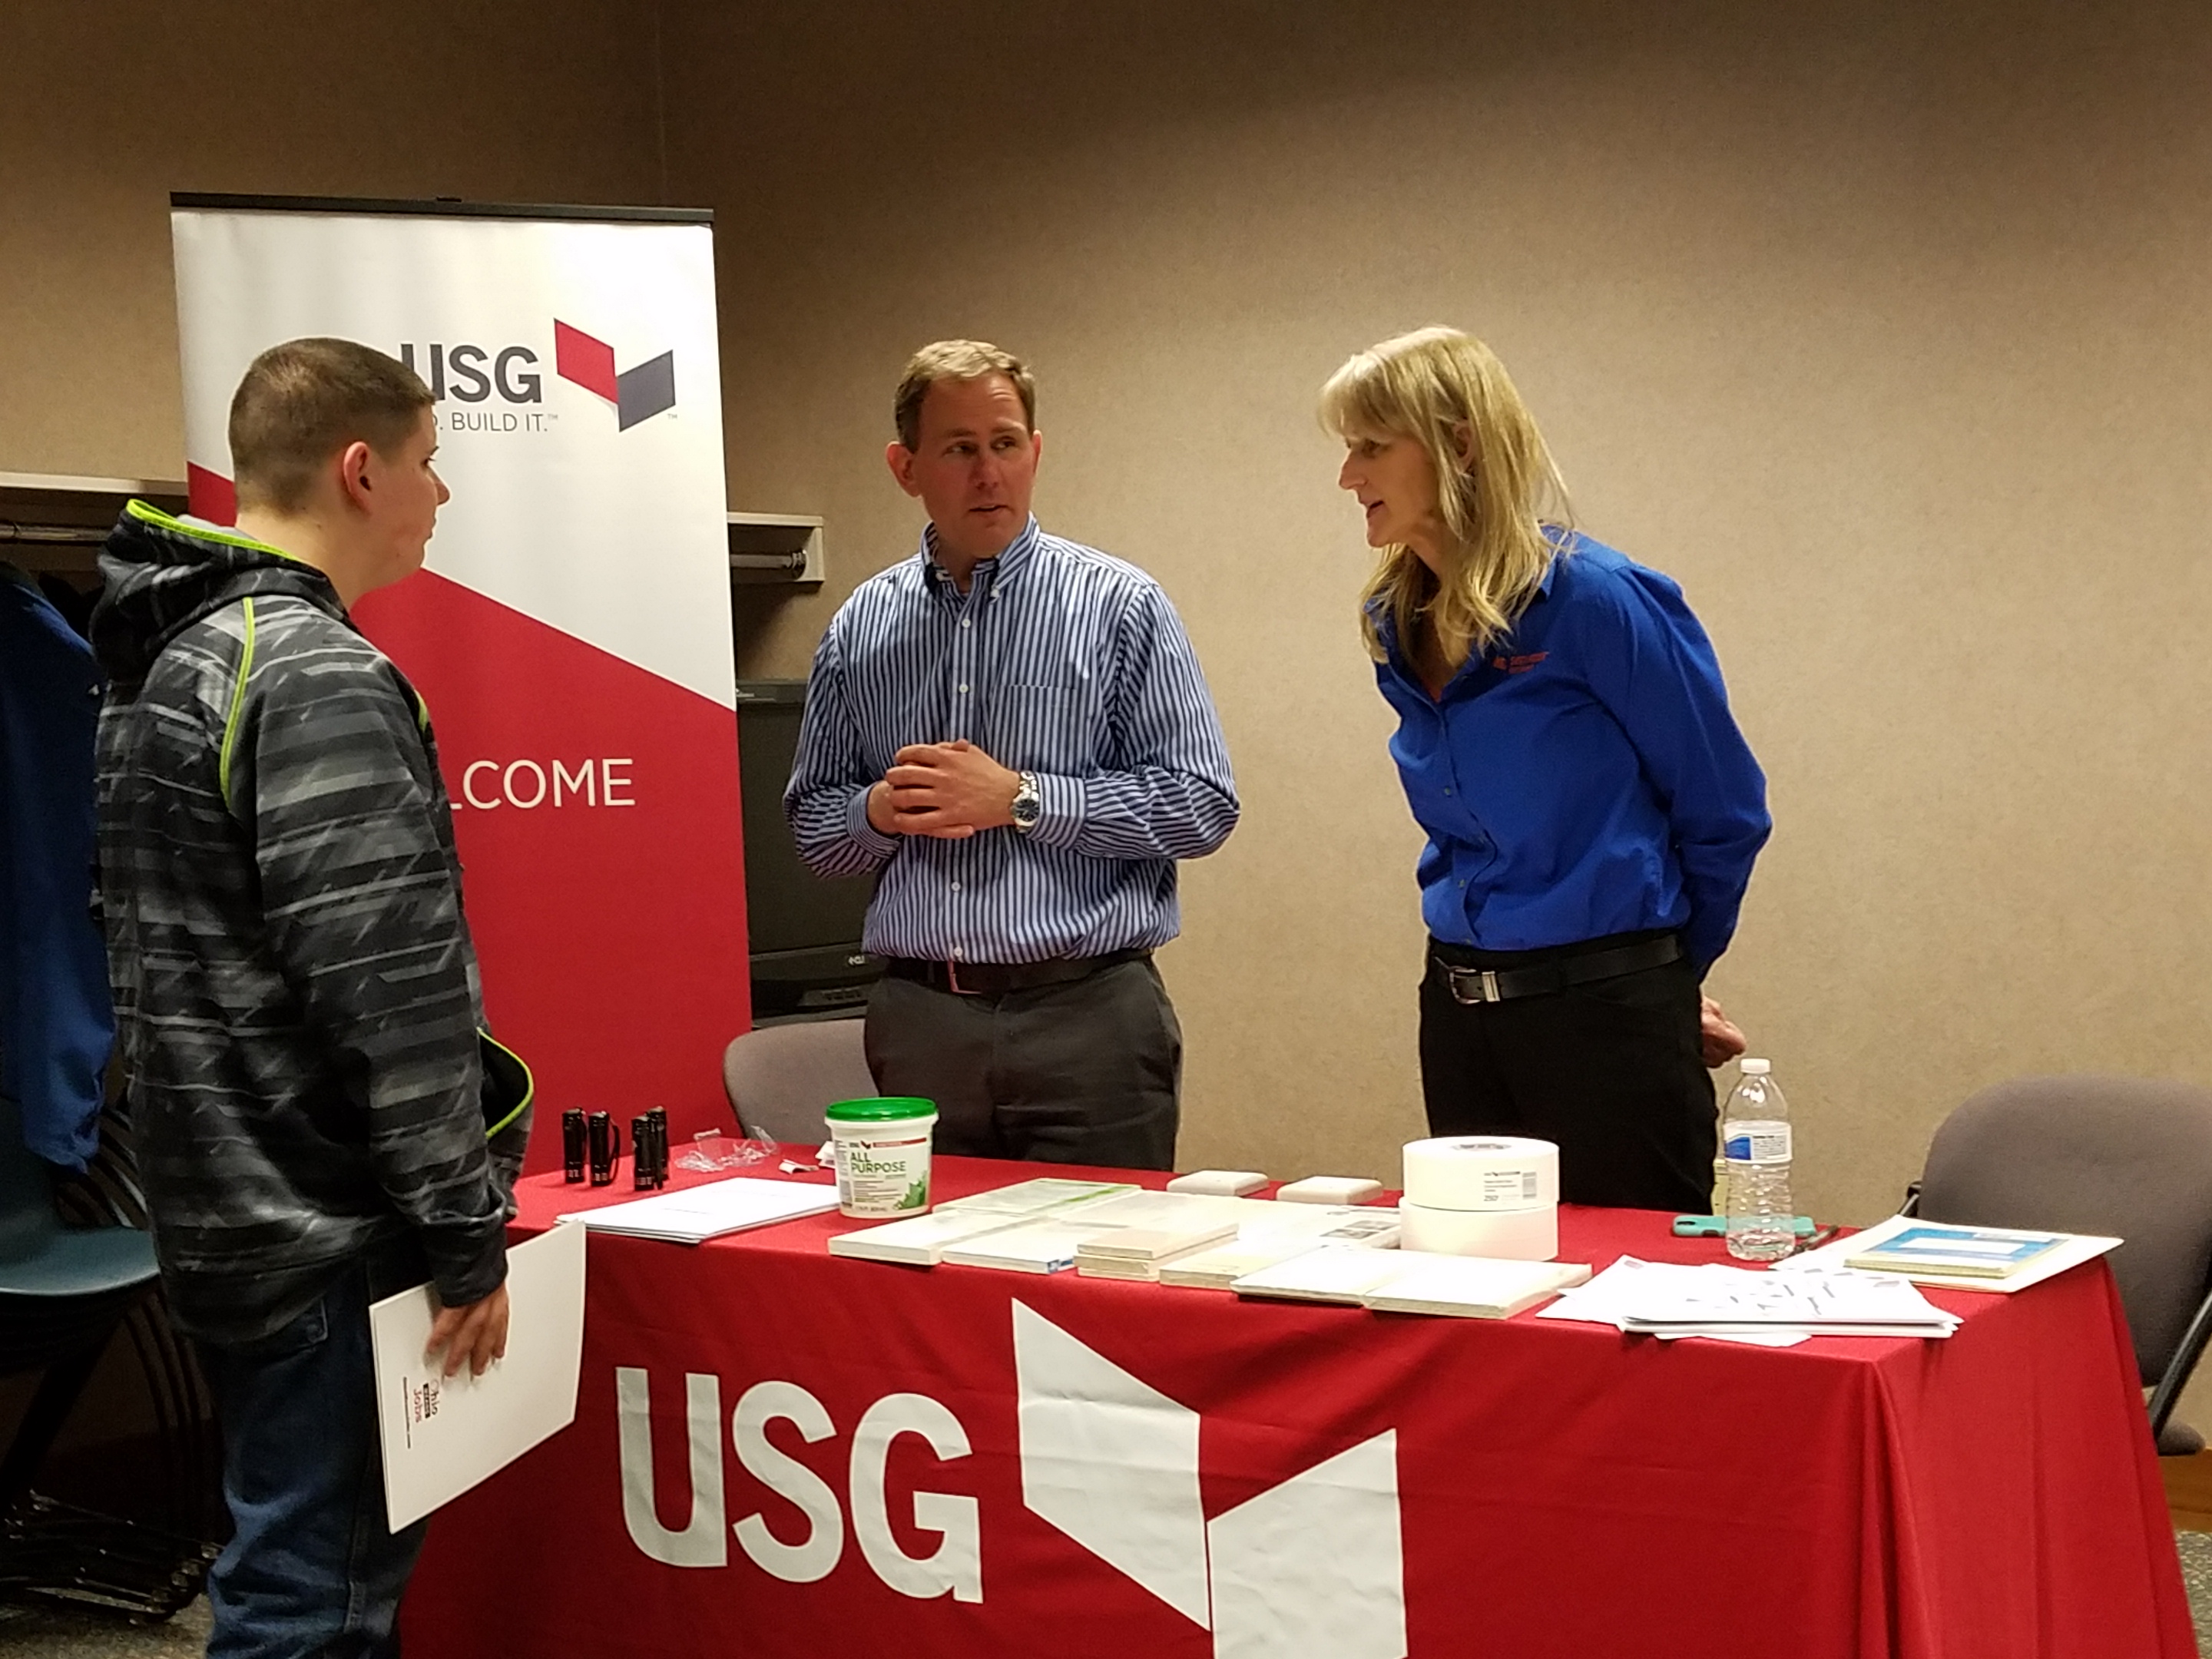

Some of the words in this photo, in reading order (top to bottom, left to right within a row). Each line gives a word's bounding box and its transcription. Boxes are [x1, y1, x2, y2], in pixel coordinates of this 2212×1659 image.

[400, 343, 543, 404] USG
[451, 412, 518, 432] BUILD
[850, 1152, 871, 1162] ALL
[851, 1161, 906, 1173] PURPOSE
[615, 1366, 983, 1604] USG
